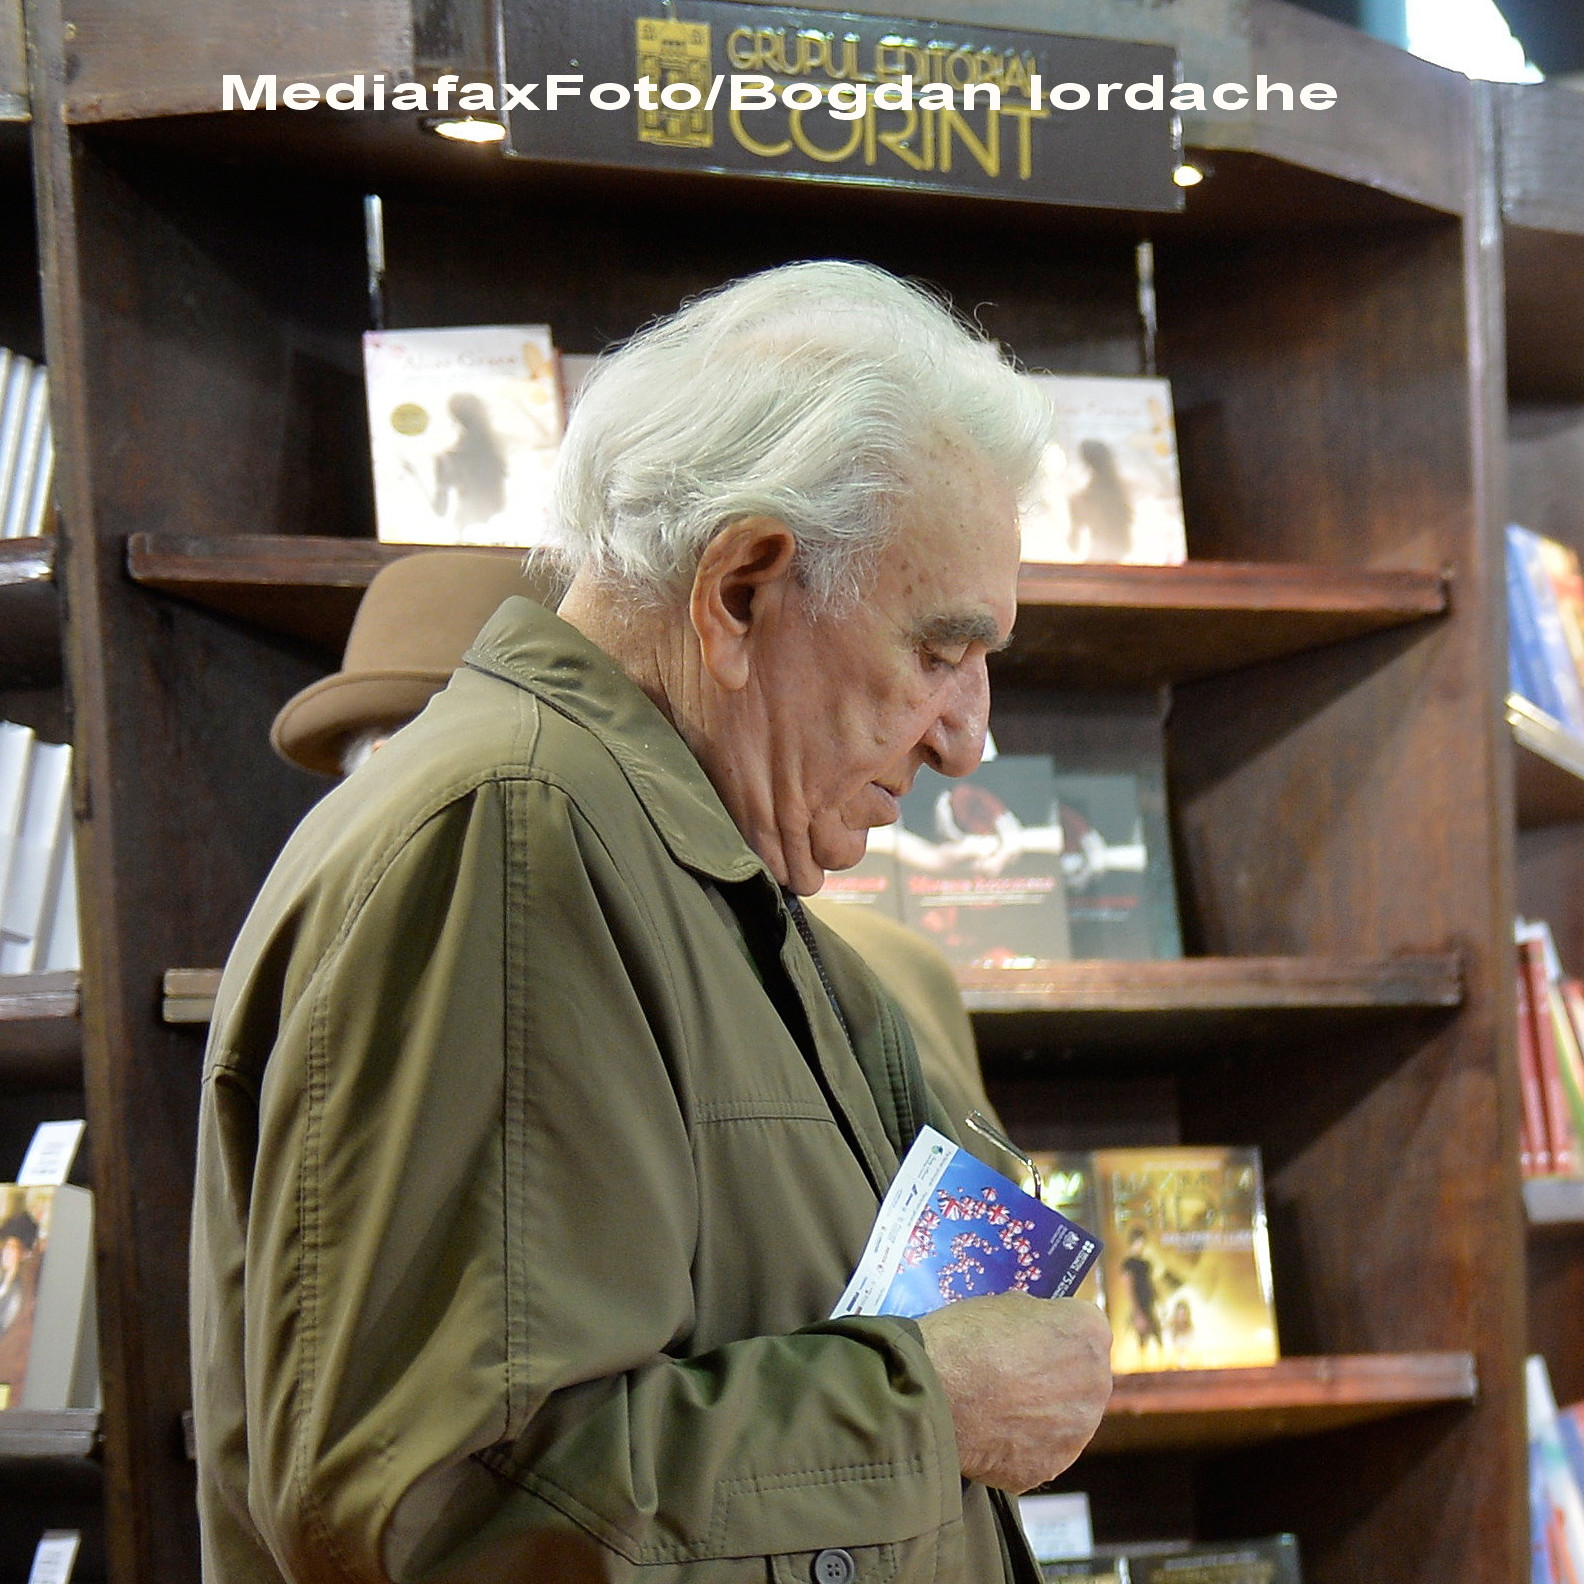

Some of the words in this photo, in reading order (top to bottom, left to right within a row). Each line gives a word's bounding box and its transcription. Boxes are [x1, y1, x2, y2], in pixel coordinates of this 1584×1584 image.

[727, 27, 862, 80] GRUPUL
[877, 38, 1045, 96] EDITORIAL
[727, 86, 1050, 180] CORINT
